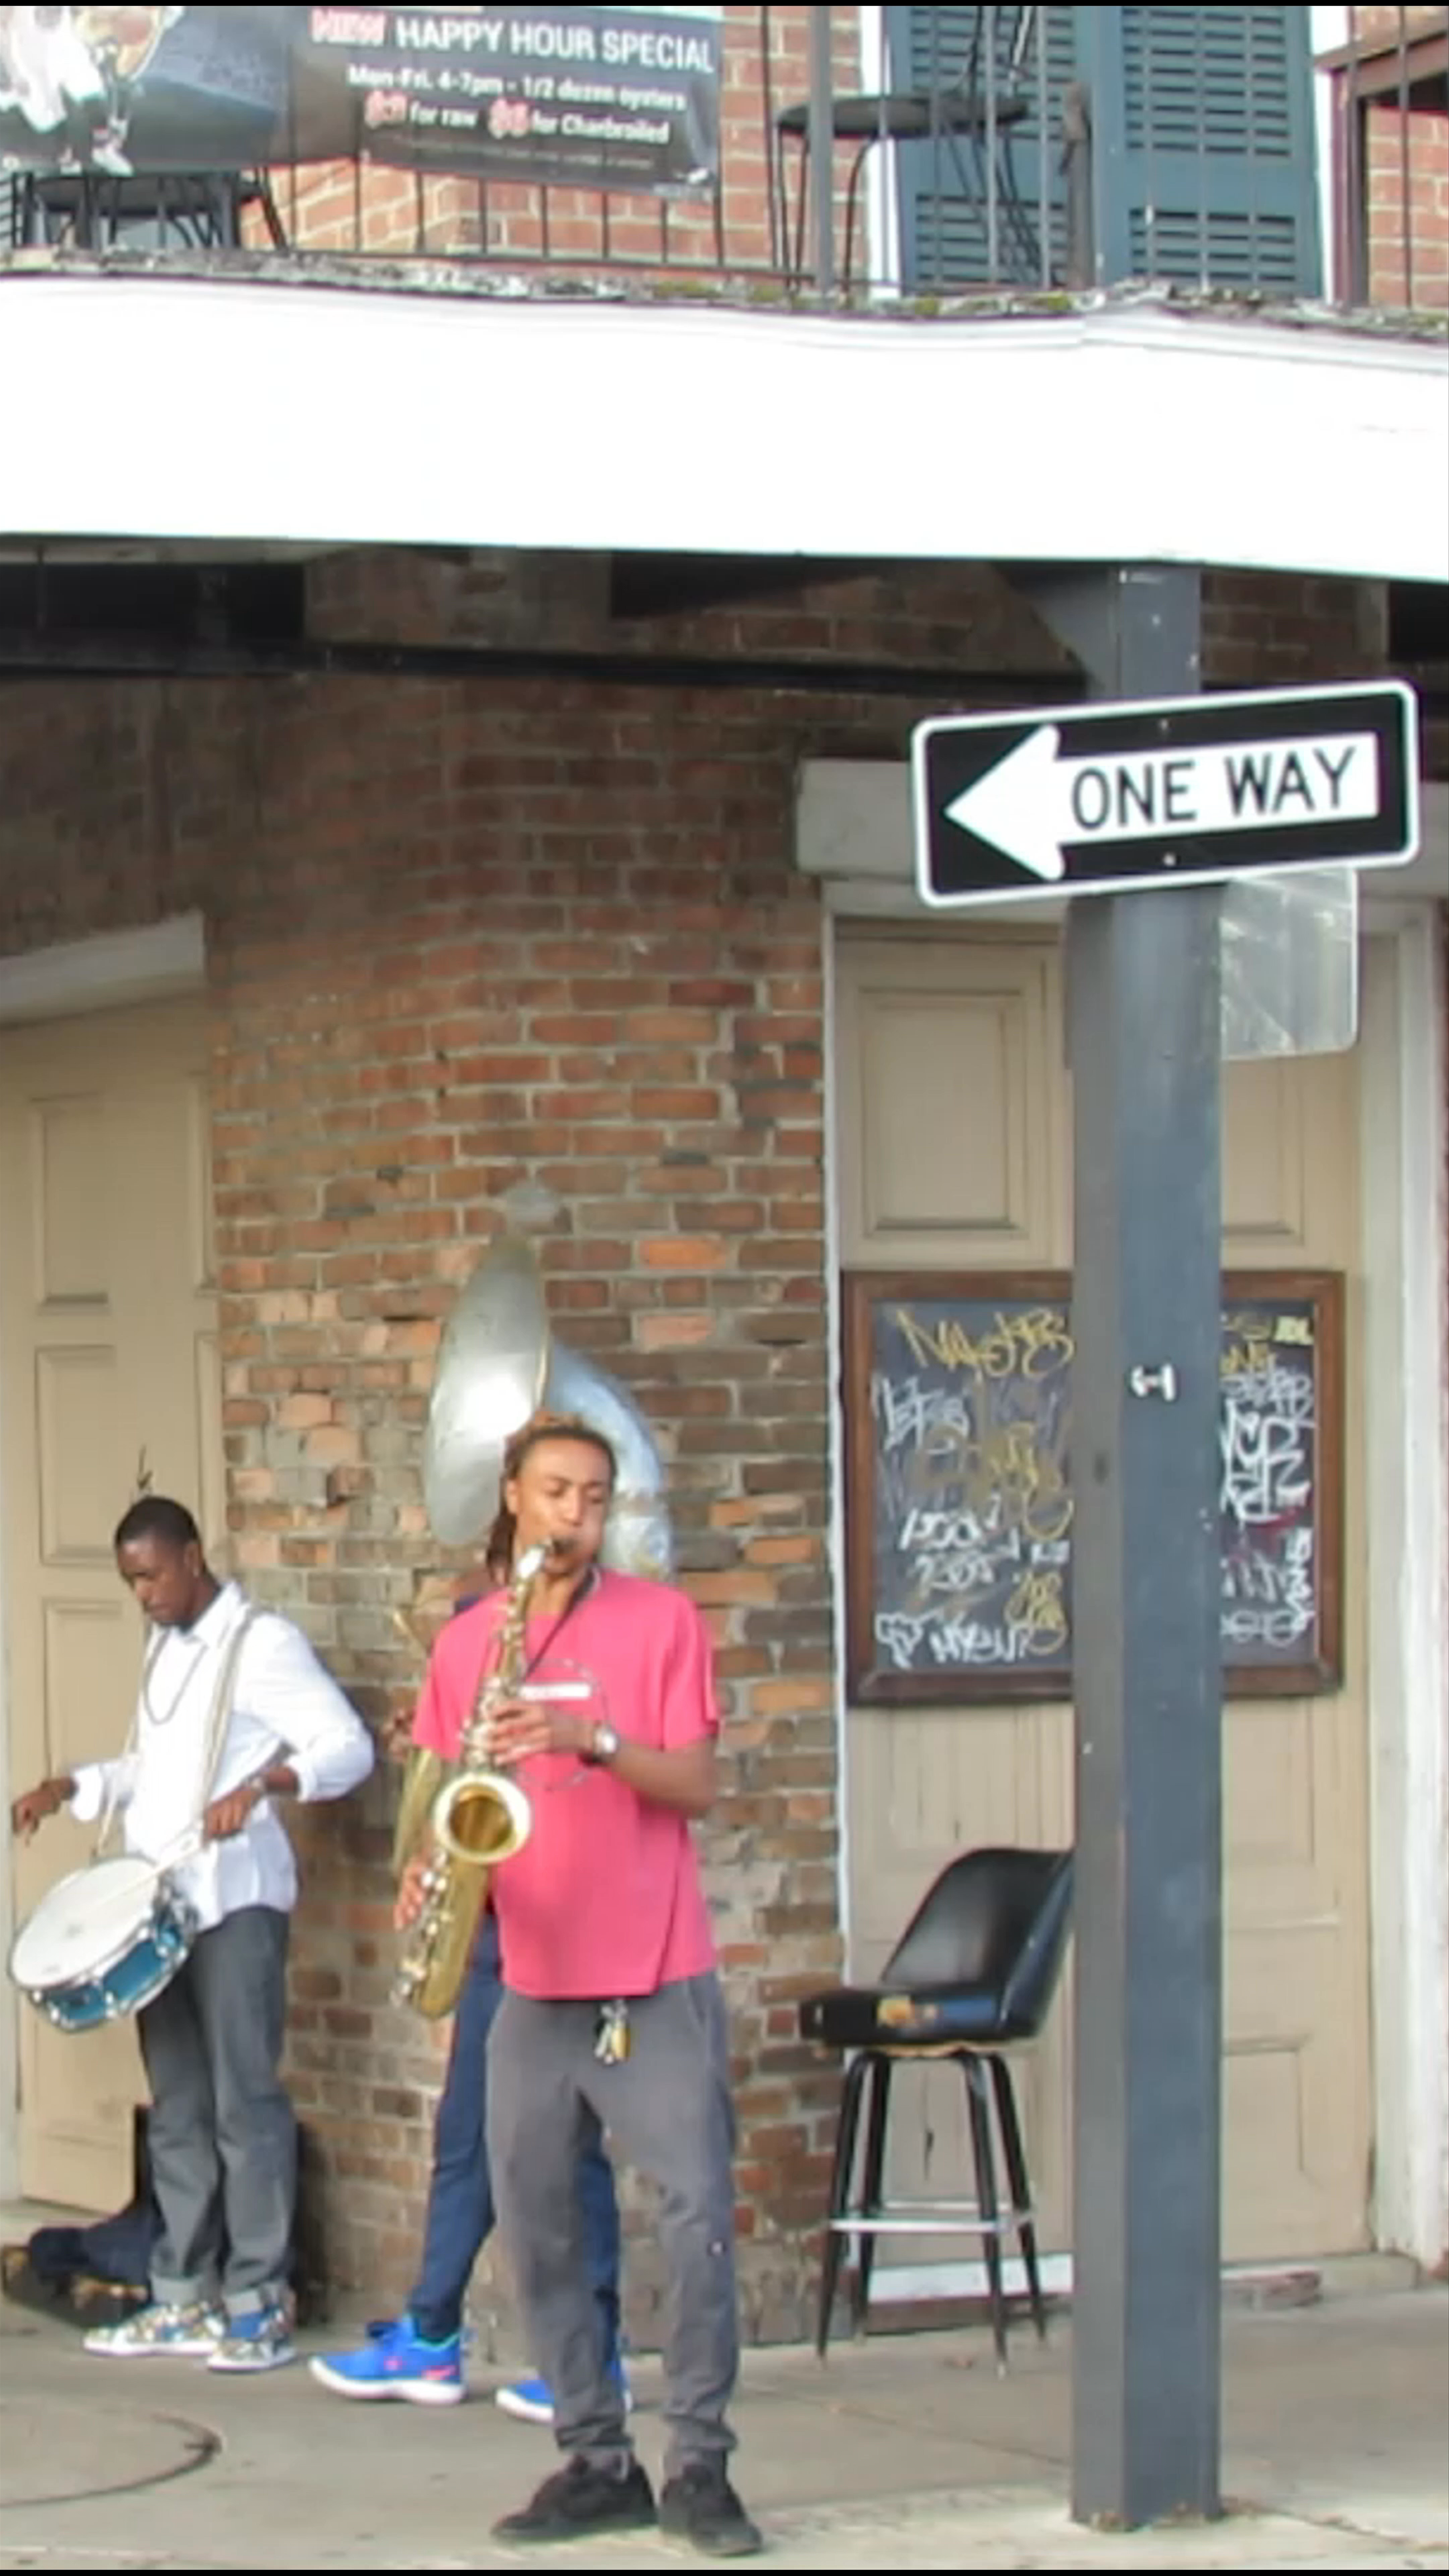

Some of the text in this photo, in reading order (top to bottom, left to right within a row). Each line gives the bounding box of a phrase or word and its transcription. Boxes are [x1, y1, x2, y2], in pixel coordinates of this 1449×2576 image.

[312, 8, 714, 74] NEW HAPPY HOUR SPECIAL
[410, 101, 438, 125] for
[441, 108, 479, 128] raw
[523, 75, 554, 100] 1/2
[558, 77, 615, 105] dozen
[620, 86, 686, 111] oysters
[1071, 746, 1357, 831] ONE WAY
